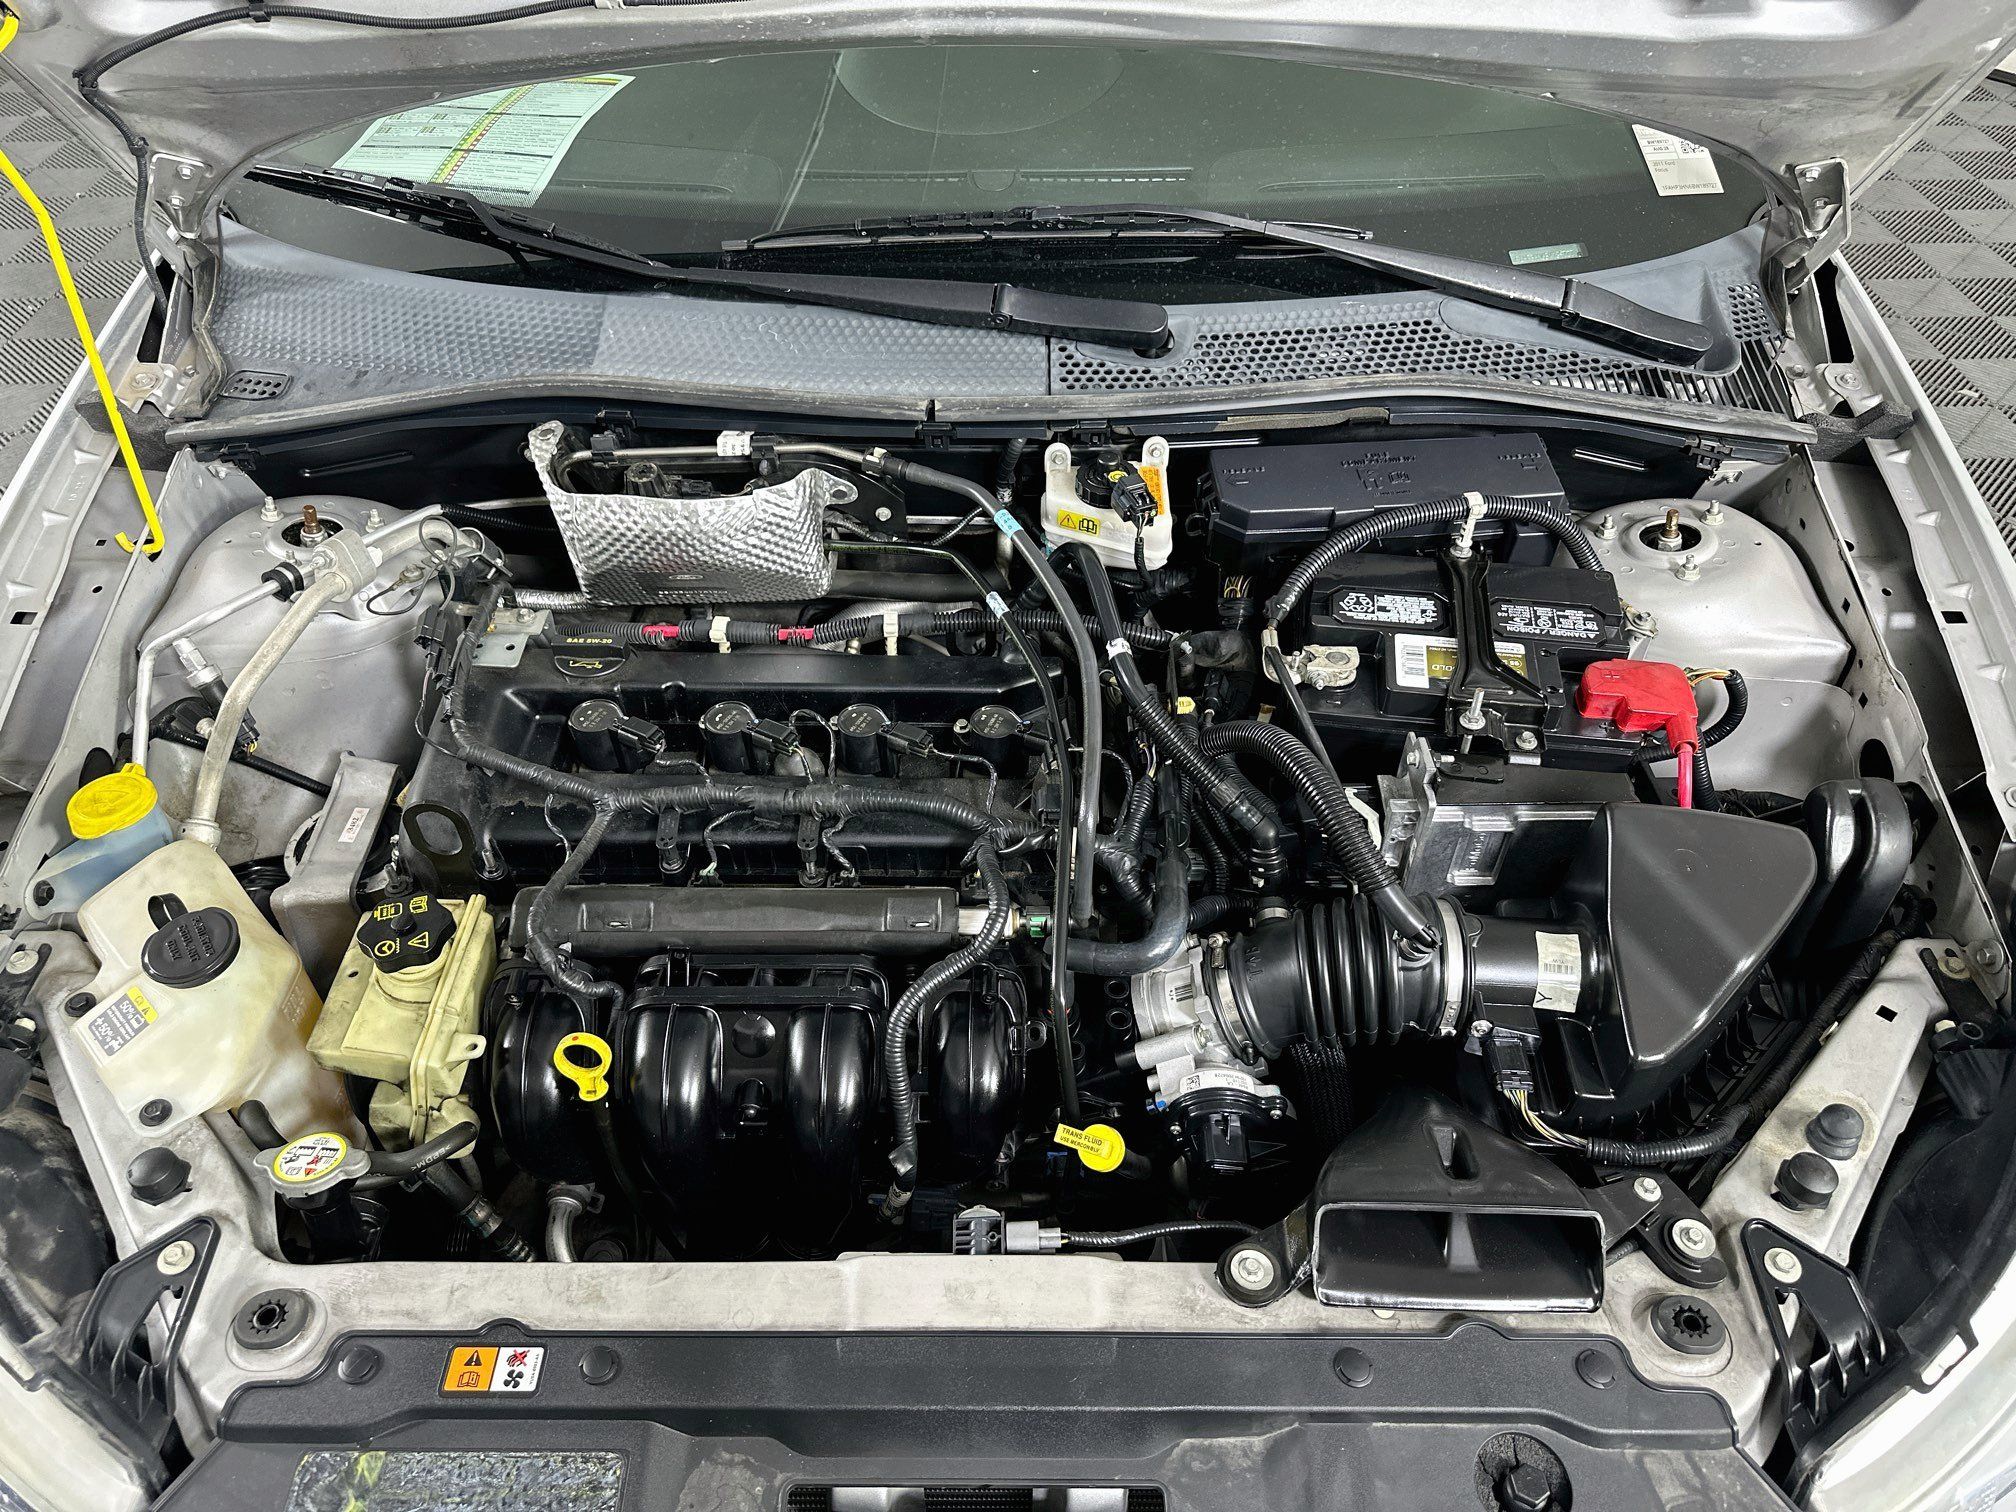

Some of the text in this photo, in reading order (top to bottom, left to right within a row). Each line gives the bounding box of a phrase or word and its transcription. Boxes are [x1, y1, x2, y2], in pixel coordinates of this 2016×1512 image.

[1506, 625, 1540, 634] POISON
[1550, 628, 1588, 639] DANGER
[1432, 664, 1455, 672] OLD
[175, 923, 201, 963] COOLANT
[192, 916, 216, 957] RADIATOR
[164, 938, 183, 961] ONLY
[119, 1000, 136, 1019] 50%
[1062, 1128, 1102, 1146] TRANS FLUID
